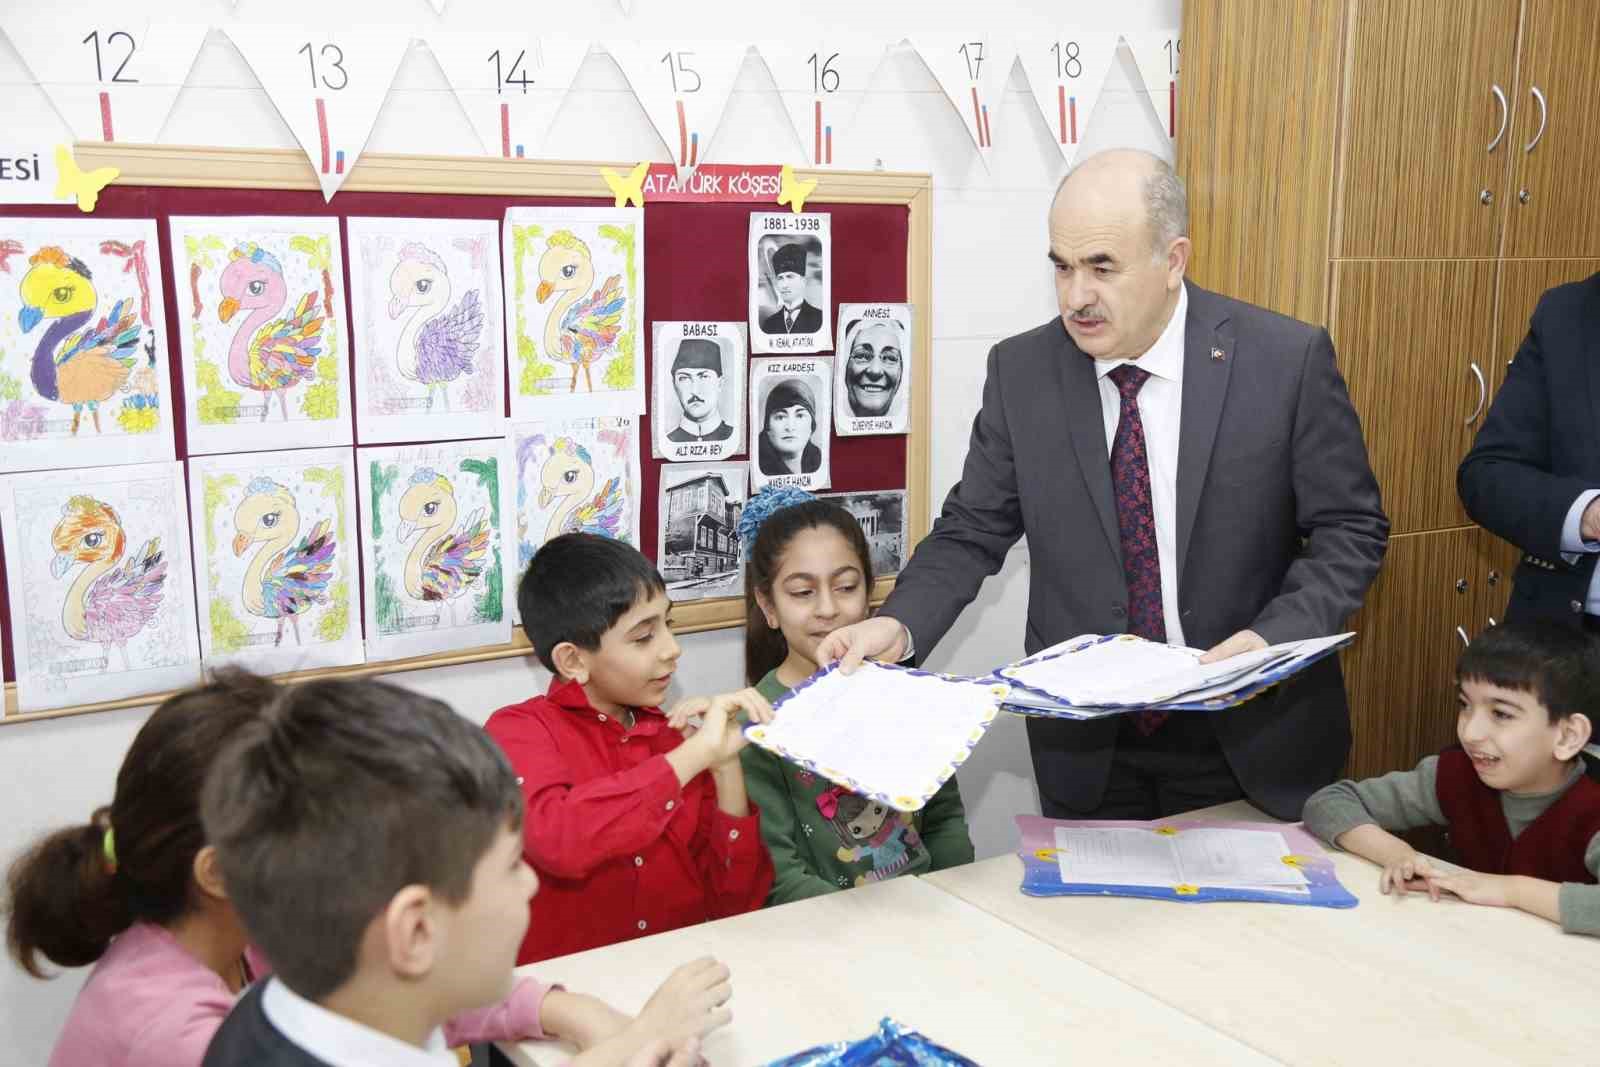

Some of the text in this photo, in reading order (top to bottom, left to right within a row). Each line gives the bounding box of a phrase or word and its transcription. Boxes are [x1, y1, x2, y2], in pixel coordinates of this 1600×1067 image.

[82, 30, 139, 83] 12
[299, 42, 348, 90] 13
[488, 48, 535, 94] 14
[661, 52, 701, 92] 15
[808, 53, 839, 93] 16
[958, 42, 984, 80] 17
[1051, 42, 1082, 78] 18
[763, 217, 821, 231] 1881-1938
[682, 323, 718, 336] BABASI
[768, 363, 781, 373] KIZ
